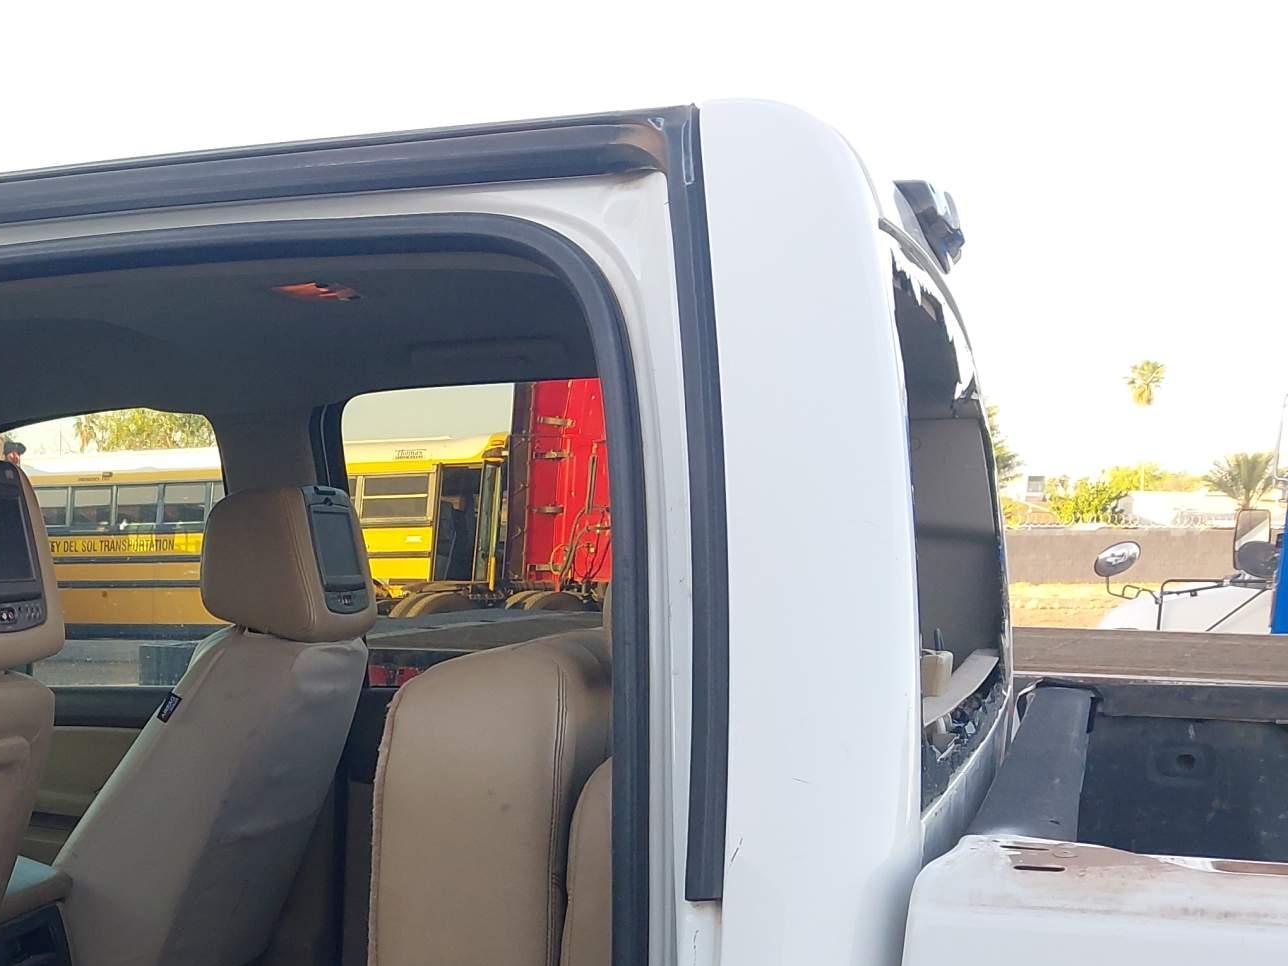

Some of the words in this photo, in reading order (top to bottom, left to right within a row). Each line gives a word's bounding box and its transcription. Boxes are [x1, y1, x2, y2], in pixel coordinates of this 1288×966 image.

[64, 540, 79, 553] DEL
[82, 540, 97, 553] SOL
[100, 539, 174, 553] TRANSPORTATION
